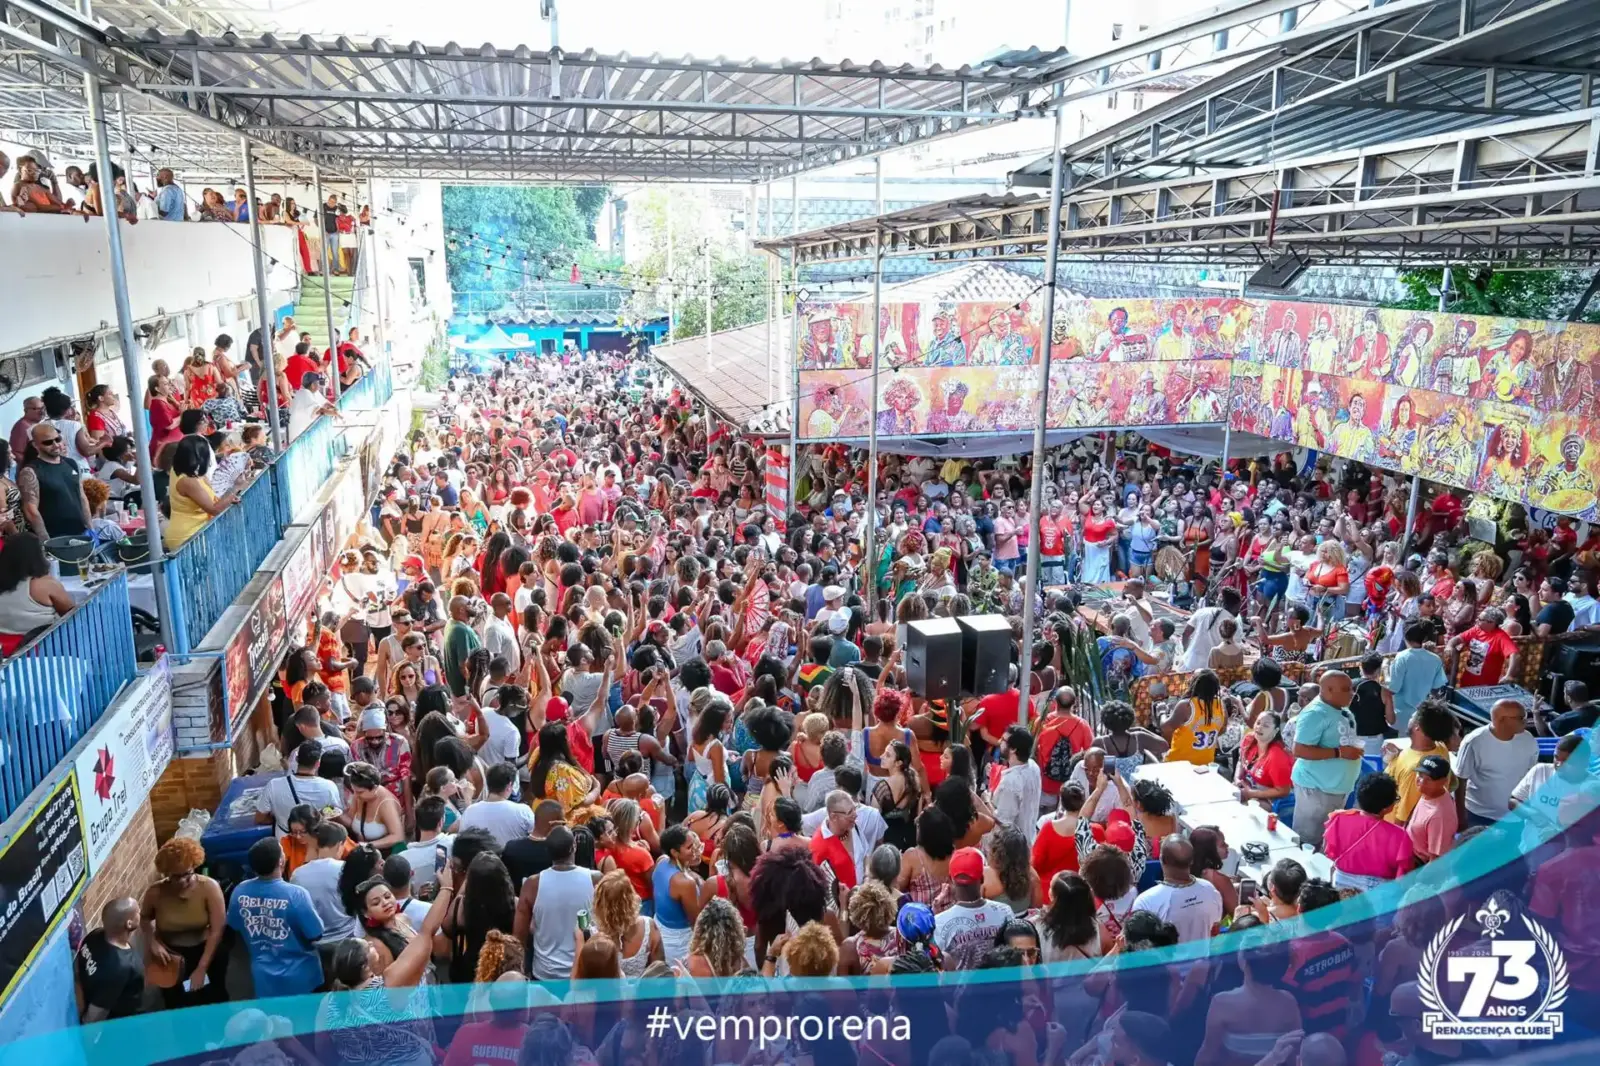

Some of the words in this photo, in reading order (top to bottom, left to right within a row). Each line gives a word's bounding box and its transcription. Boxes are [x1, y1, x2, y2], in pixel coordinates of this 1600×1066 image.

[90, 806, 113, 846] Grupo
[112, 779, 128, 814] Trel
[6, 900, 17, 918] do
[18, 865, 42, 903] Brasil
[238, 895, 288, 910] BELIEVE
[240, 908, 285, 930] BETTER
[247, 924, 290, 940] WORLD
